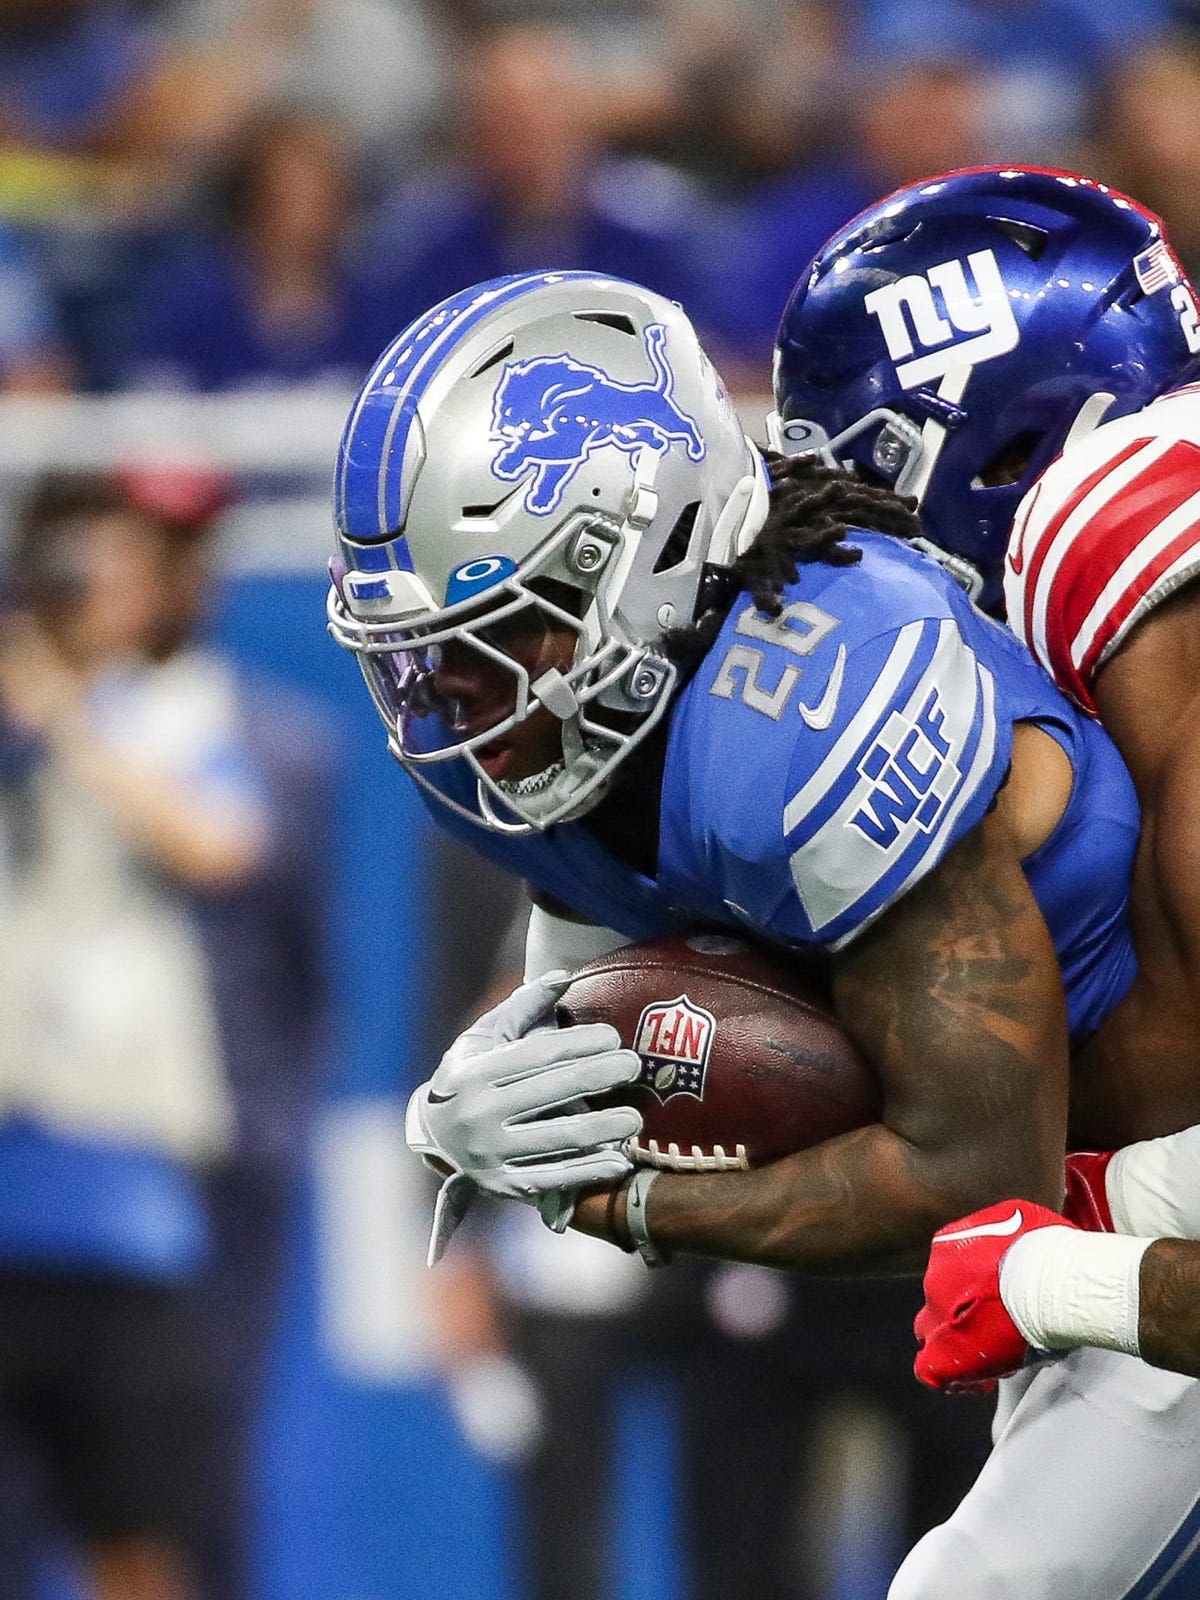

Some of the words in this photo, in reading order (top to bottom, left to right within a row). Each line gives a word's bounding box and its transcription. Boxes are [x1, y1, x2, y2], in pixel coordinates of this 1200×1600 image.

[864, 249, 1020, 390] ny
[845, 682, 951, 852] WCF
[647, 1010, 705, 1060] NFL
